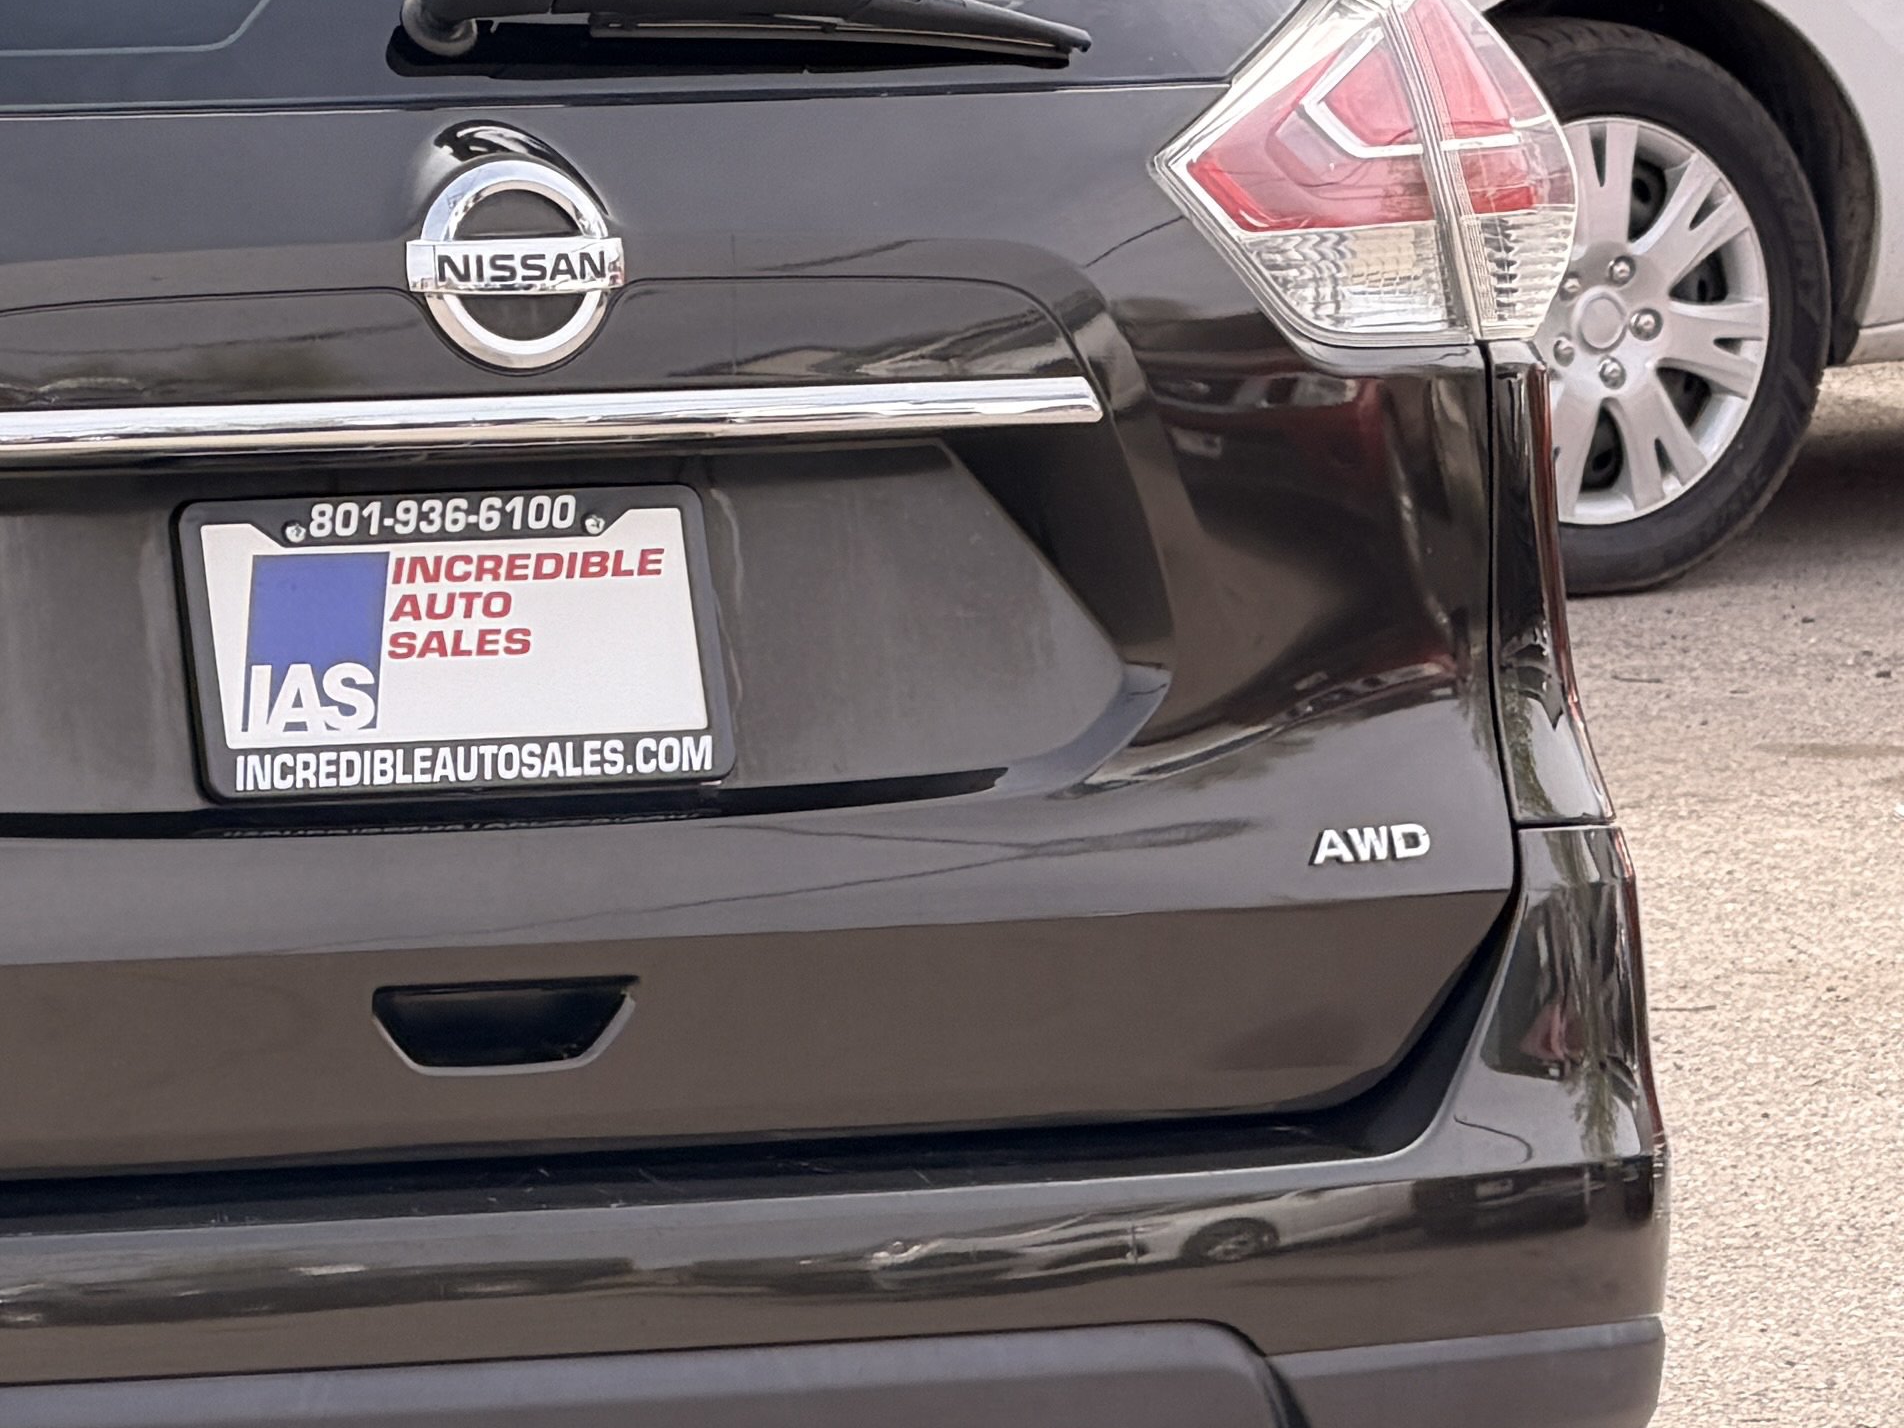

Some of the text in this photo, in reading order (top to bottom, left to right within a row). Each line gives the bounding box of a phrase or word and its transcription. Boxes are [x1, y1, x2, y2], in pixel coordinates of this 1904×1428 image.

[437, 250, 606, 283] NISSAN
[309, 494, 577, 538] 801-936-6100
[392, 548, 665, 585] INCREDIBLE
[389, 590, 512, 622] AUTO
[387, 627, 532, 660] SALES
[245, 662, 376, 733] IAS
[235, 735, 714, 793] INCREDIBLEAUTOSALES.COM
[1309, 823, 1431, 865] AWD
